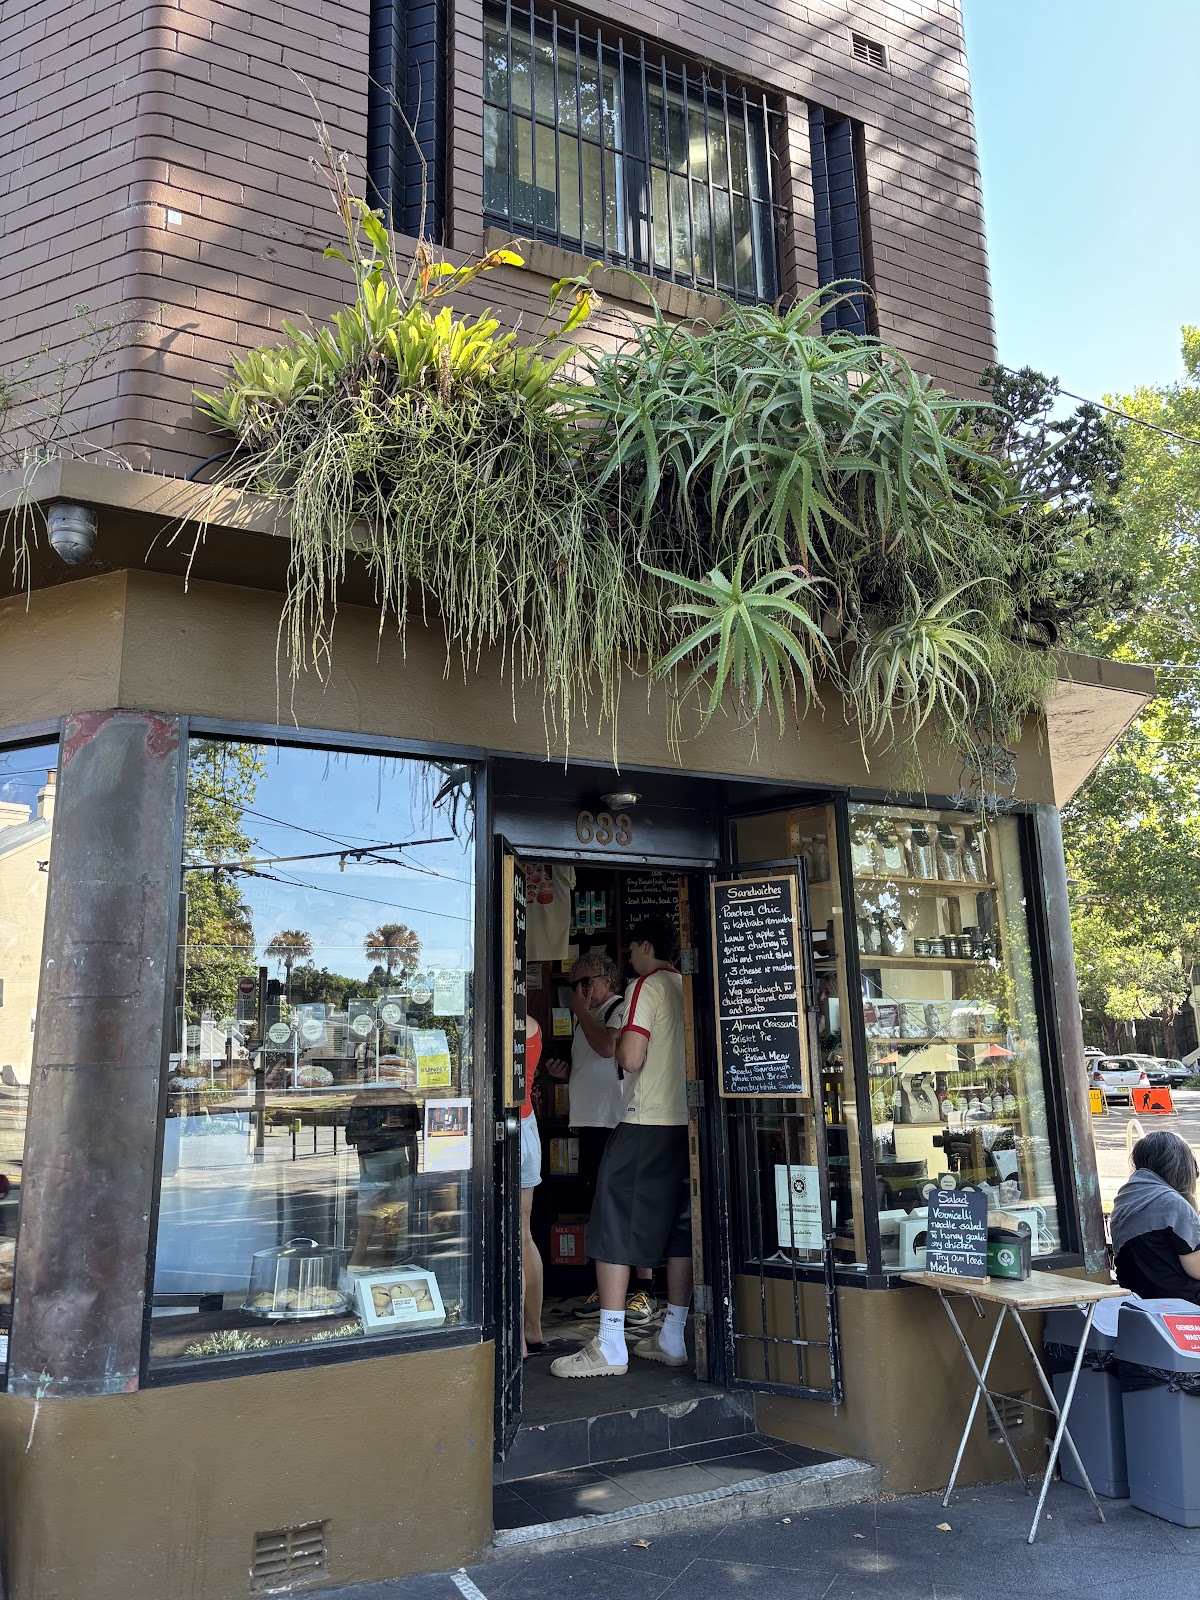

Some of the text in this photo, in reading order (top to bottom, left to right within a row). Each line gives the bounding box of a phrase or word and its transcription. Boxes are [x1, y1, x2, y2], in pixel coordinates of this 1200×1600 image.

[576, 811, 632, 846] 633
[727, 883, 781, 898] Sandwiches
[721, 903, 781, 917] Poached Chic
[724, 932, 744, 942] Lamb
[756, 928, 775, 940] apple
[748, 939, 779, 950] chutney
[740, 953, 753, 963] and
[756, 950, 774, 960] mint
[729, 967, 737, 975] 3
[729, 987, 742, 998] Veg
[745, 981, 782, 994] sandwich
[722, 996, 752, 1006] chickpea
[729, 1005, 742, 1014] and
[732, 1015, 798, 1032] Almond Croissant
[728, 1032, 756, 1044] Brisket
[733, 1045, 759, 1055] Quiches
[743, 1051, 790, 1062] Bread Menu
[938, 1191, 969, 1204] Salad
[932, 1207, 971, 1220] Vermicelli
[930, 1220, 985, 1230] noodle salad
[940, 1229, 963, 1243] honey
[965, 1232, 987, 1243] garlic
[945, 1240, 976, 1250] chicken
[933, 1253, 949, 1263] Try
[967, 1254, 984, 1265] Iced
